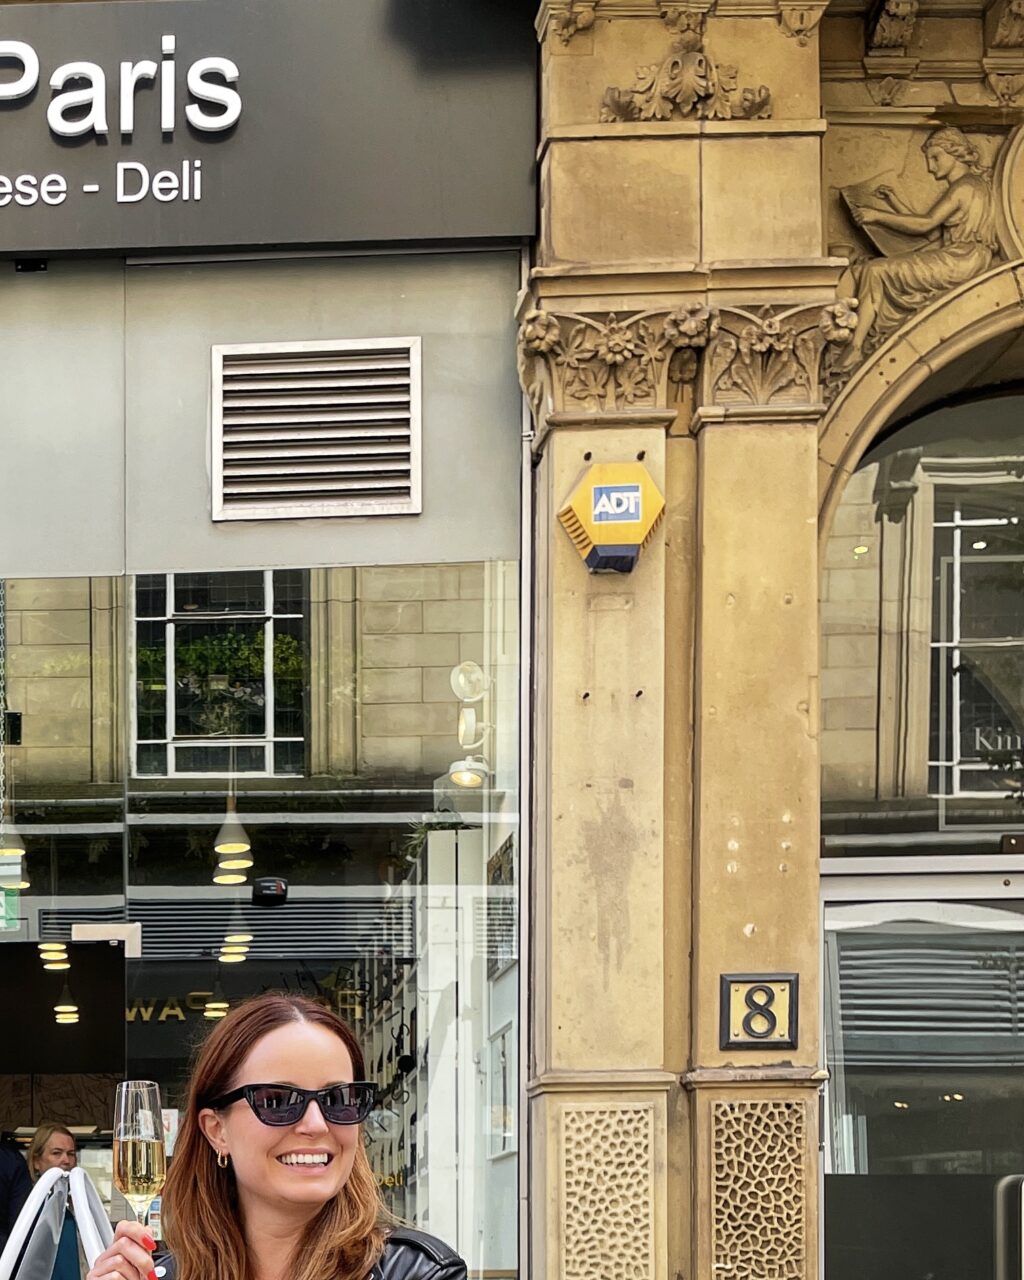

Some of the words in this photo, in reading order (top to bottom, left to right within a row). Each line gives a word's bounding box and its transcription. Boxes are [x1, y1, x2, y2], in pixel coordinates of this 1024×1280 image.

[83, 184, 99, 193] -
[116, 159, 203, 204] Deli
[593, 491, 640, 515] ADT
[742, 985, 777, 1039] 8
